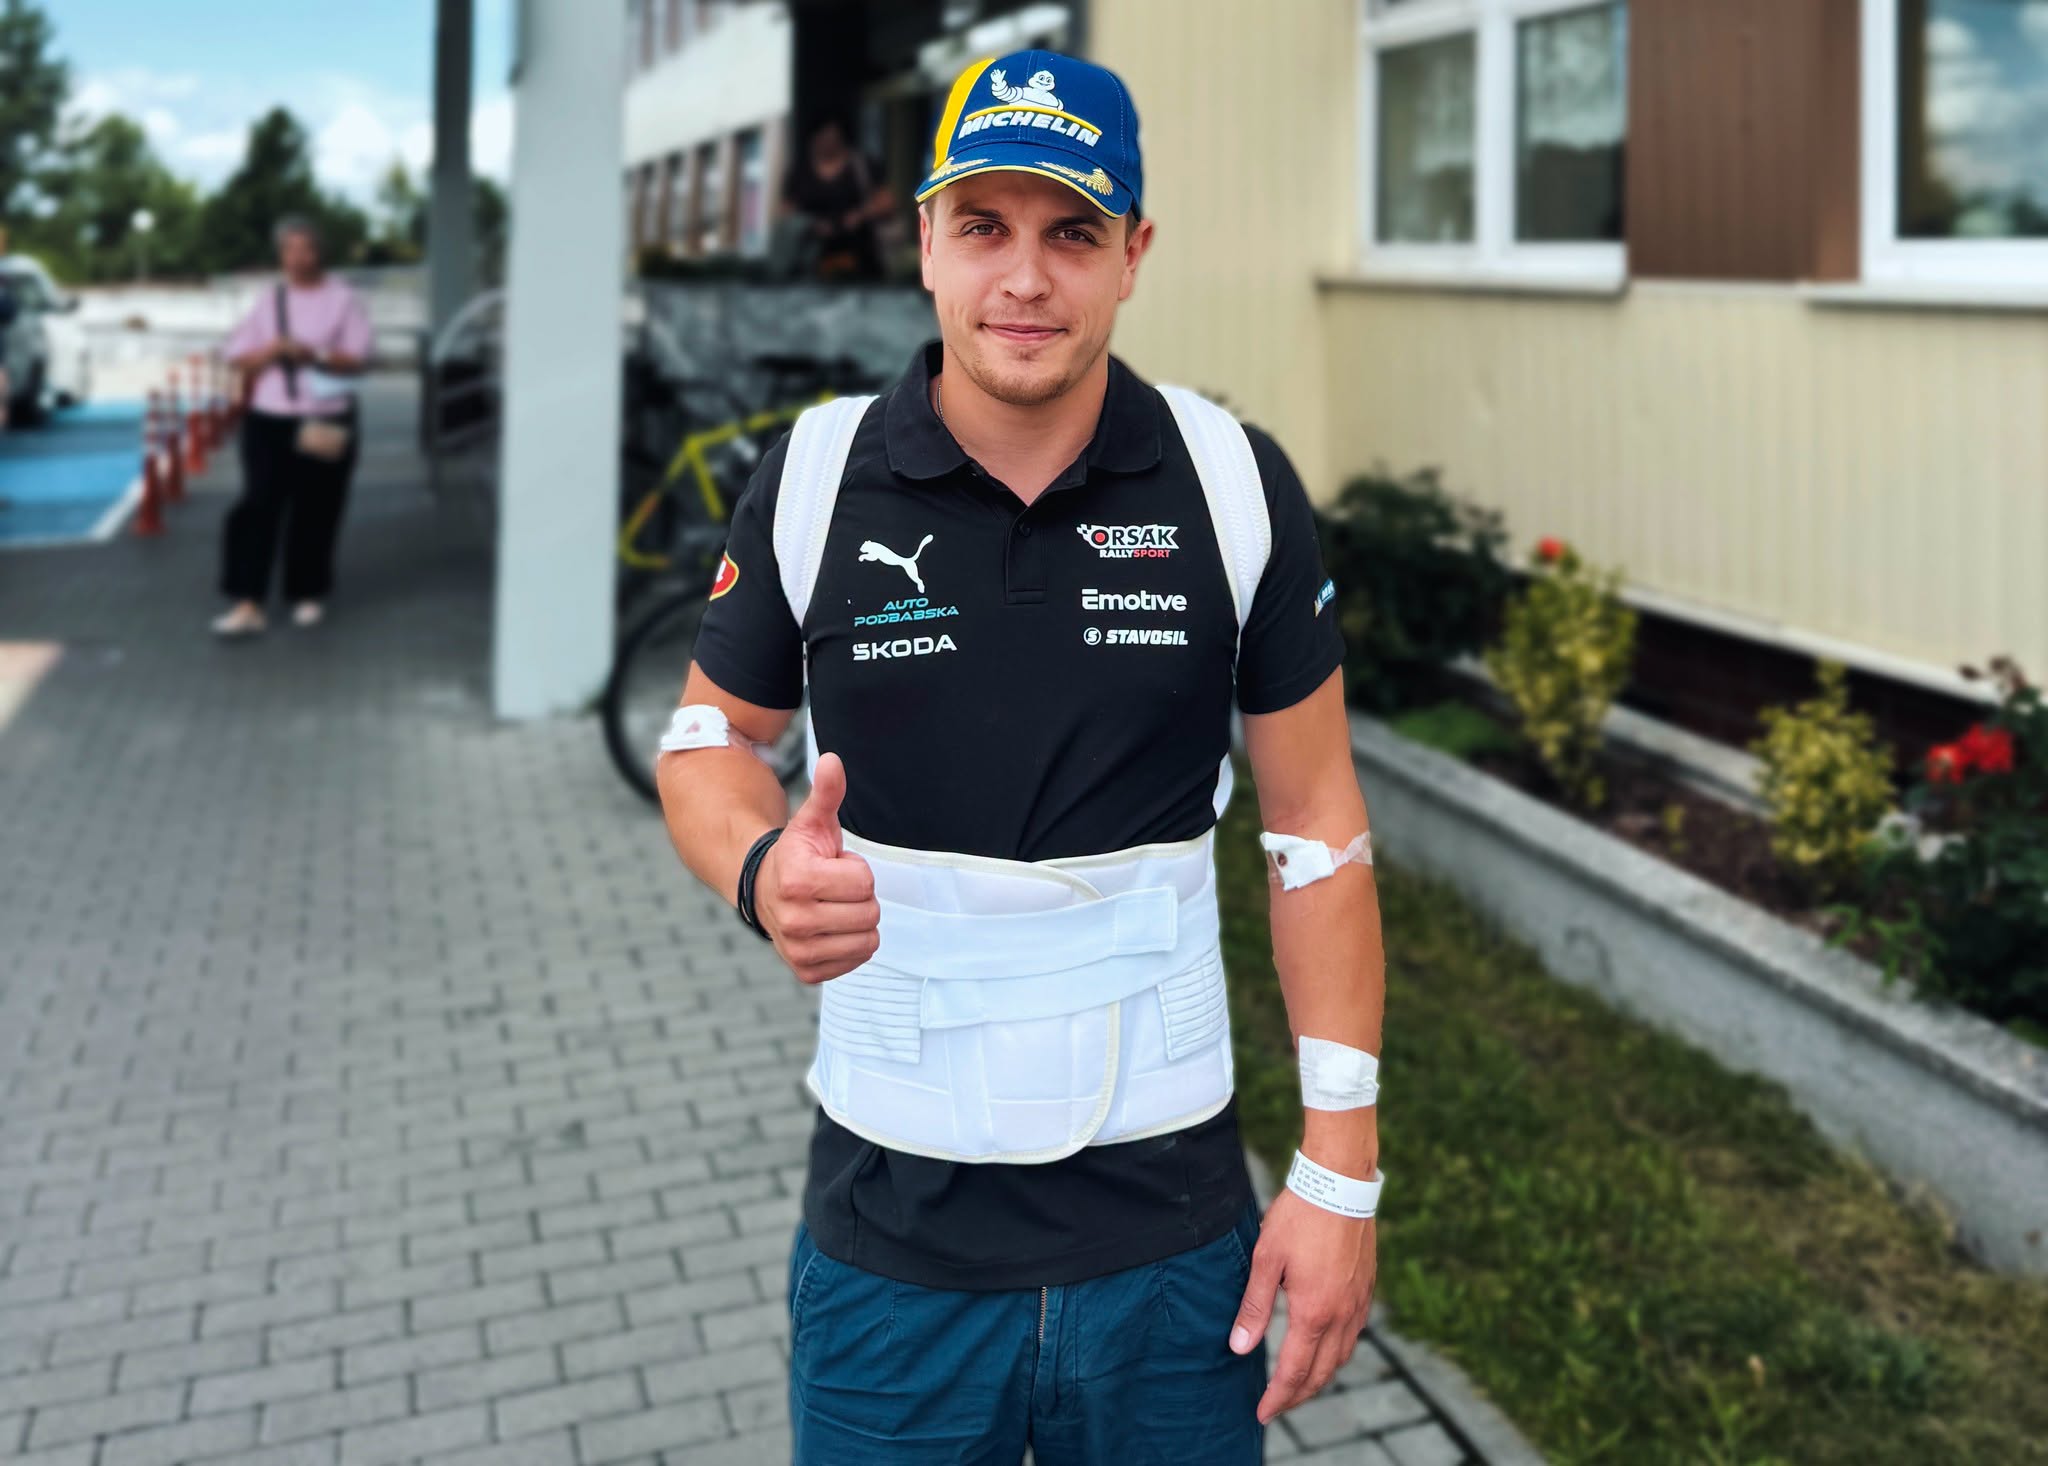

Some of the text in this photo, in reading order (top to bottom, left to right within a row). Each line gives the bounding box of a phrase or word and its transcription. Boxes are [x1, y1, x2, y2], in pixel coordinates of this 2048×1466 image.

[958, 111, 1100, 147] MICHELIN
[1100, 549, 1171, 558] RALLYSPORT
[882, 597, 929, 612] AUTO
[1081, 588, 1188, 611] Emotive
[1105, 629, 1189, 645] STAVOSIL
